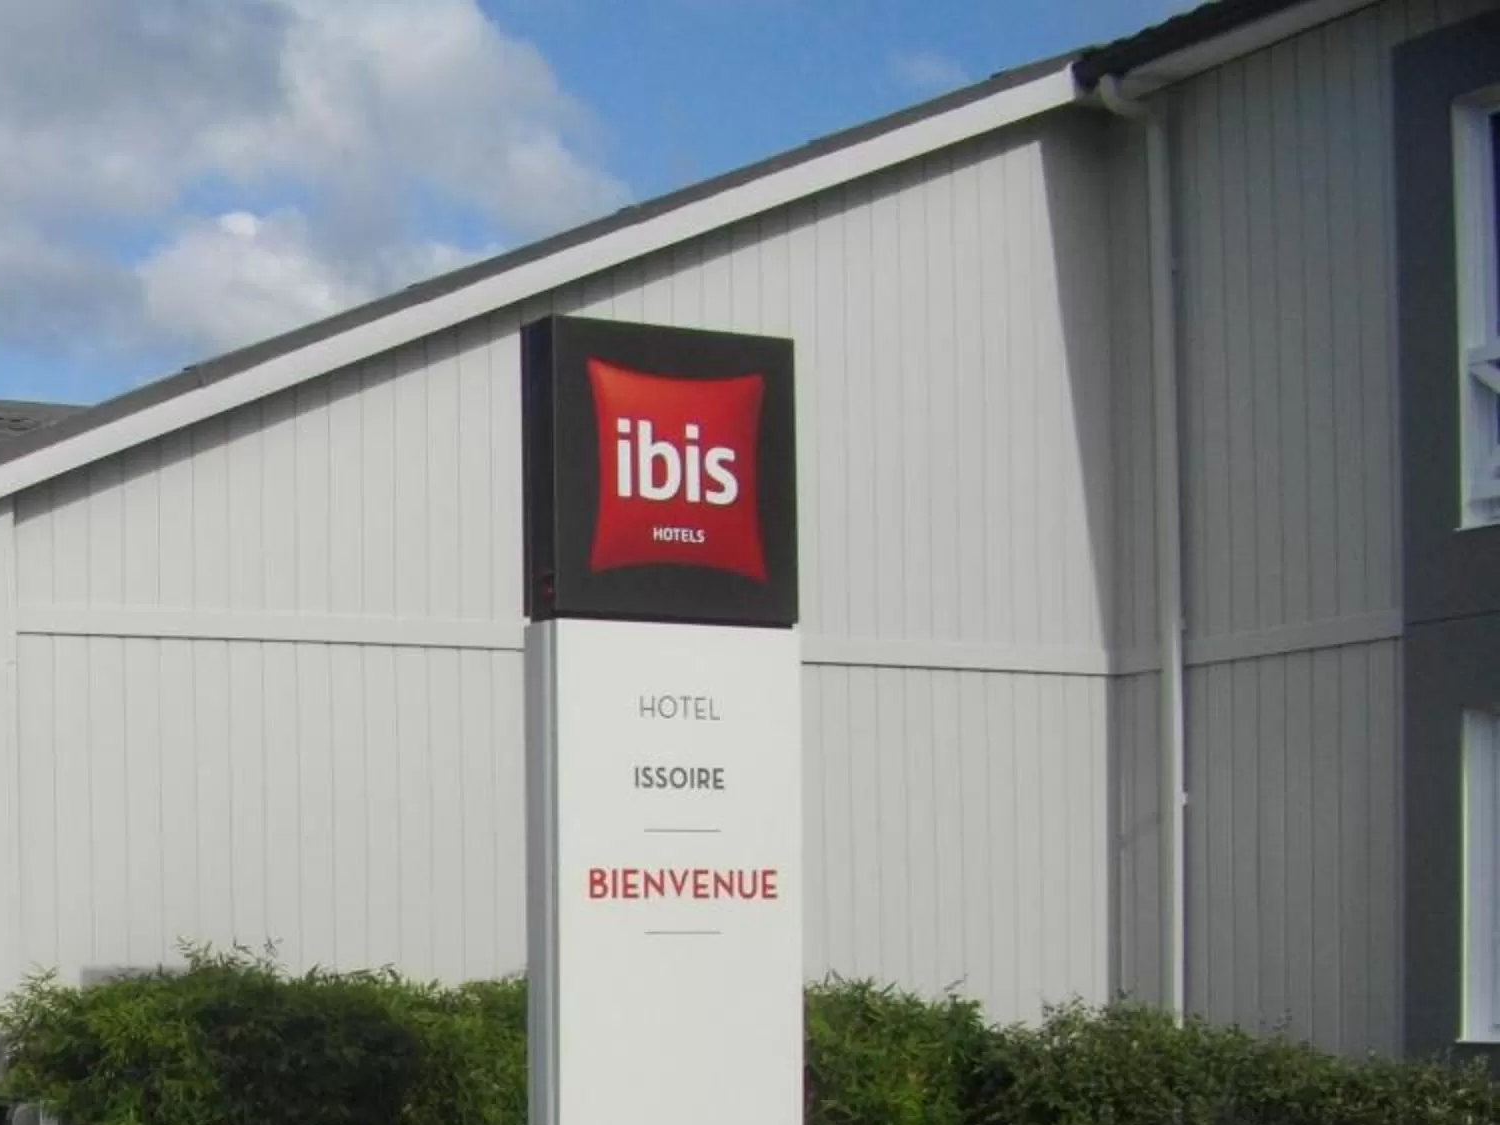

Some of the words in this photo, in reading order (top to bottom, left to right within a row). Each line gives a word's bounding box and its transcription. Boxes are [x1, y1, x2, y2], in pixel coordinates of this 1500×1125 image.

[616, 417, 740, 505] ibis
[653, 527, 705, 543] HOTELS
[639, 695, 721, 721] HOTEL
[634, 766, 725, 790] ISSOIRE
[588, 867, 778, 900] BIENVENUE
